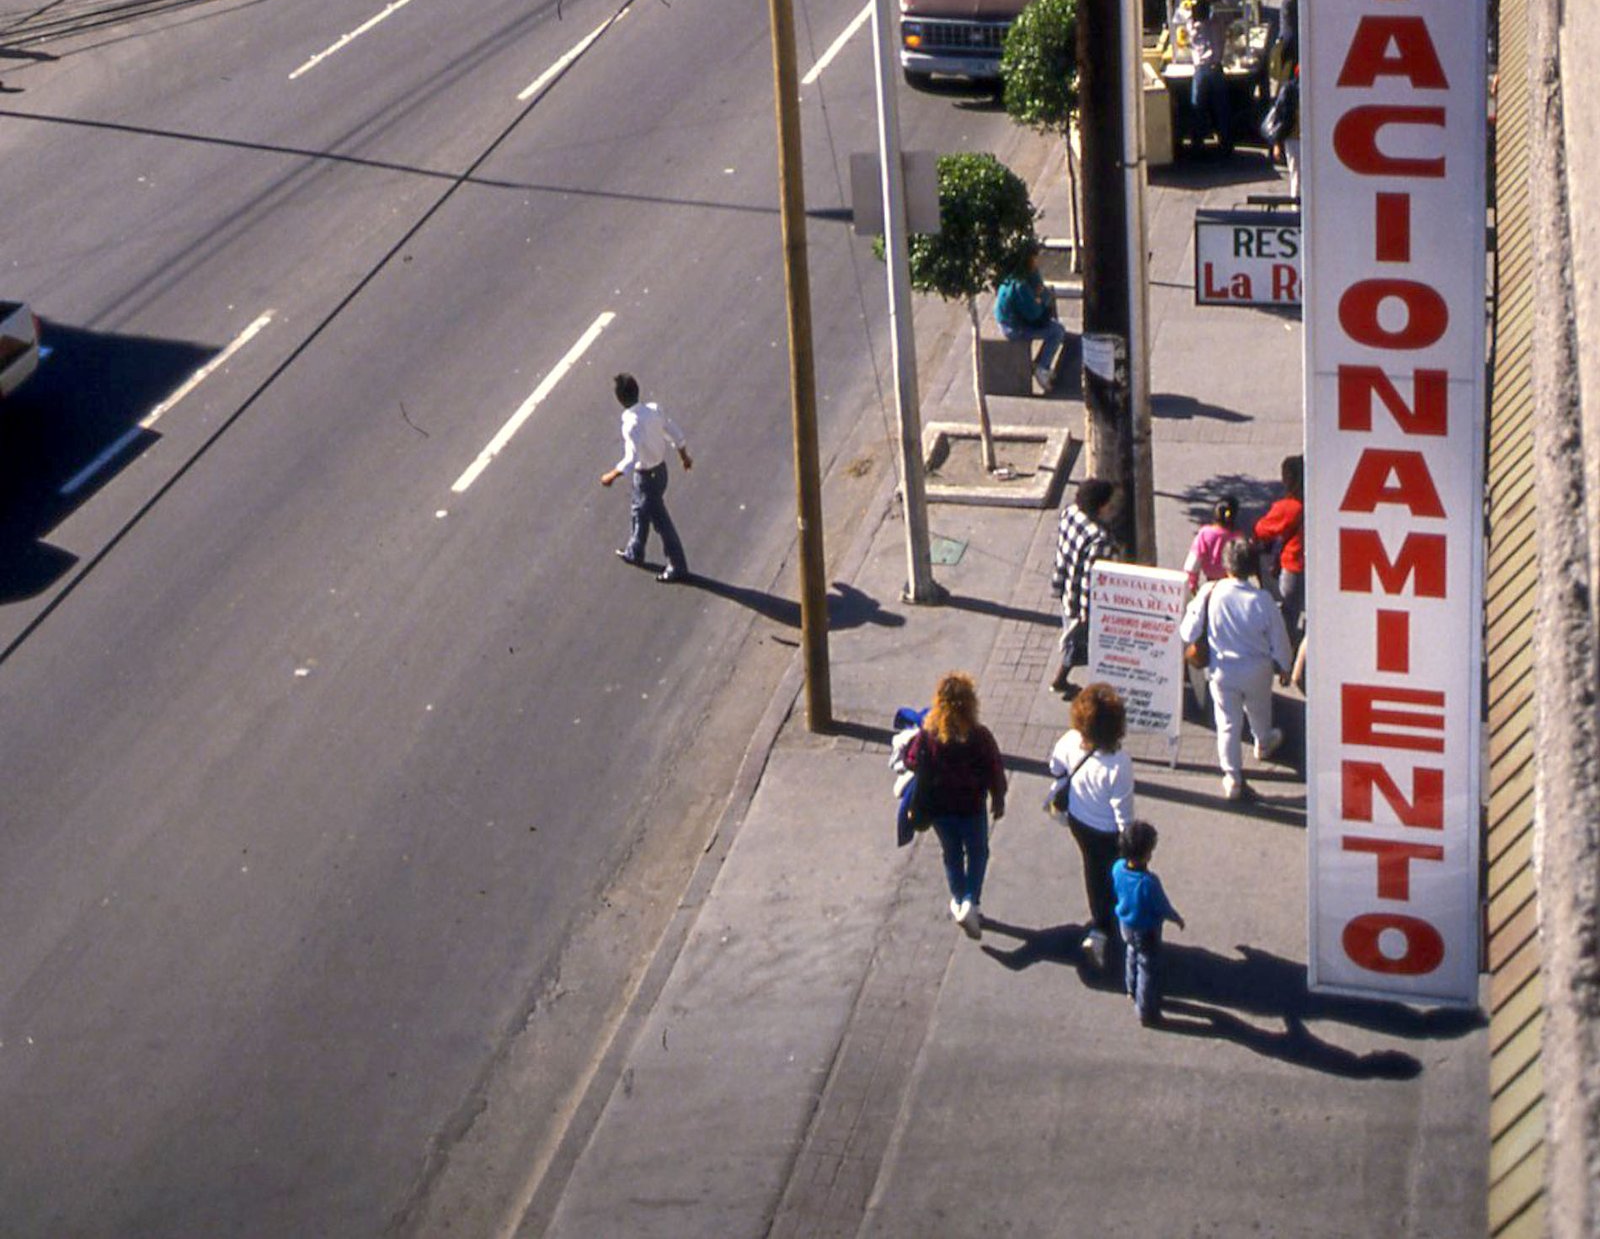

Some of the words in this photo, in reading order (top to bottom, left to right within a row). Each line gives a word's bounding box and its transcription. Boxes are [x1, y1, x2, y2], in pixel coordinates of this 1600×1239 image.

[1233, 227, 1302, 259] RES
[1204, 262, 1253, 300] La
[1272, 263, 1302, 301] R
[1109, 577, 1182, 597] RESTAURANT
